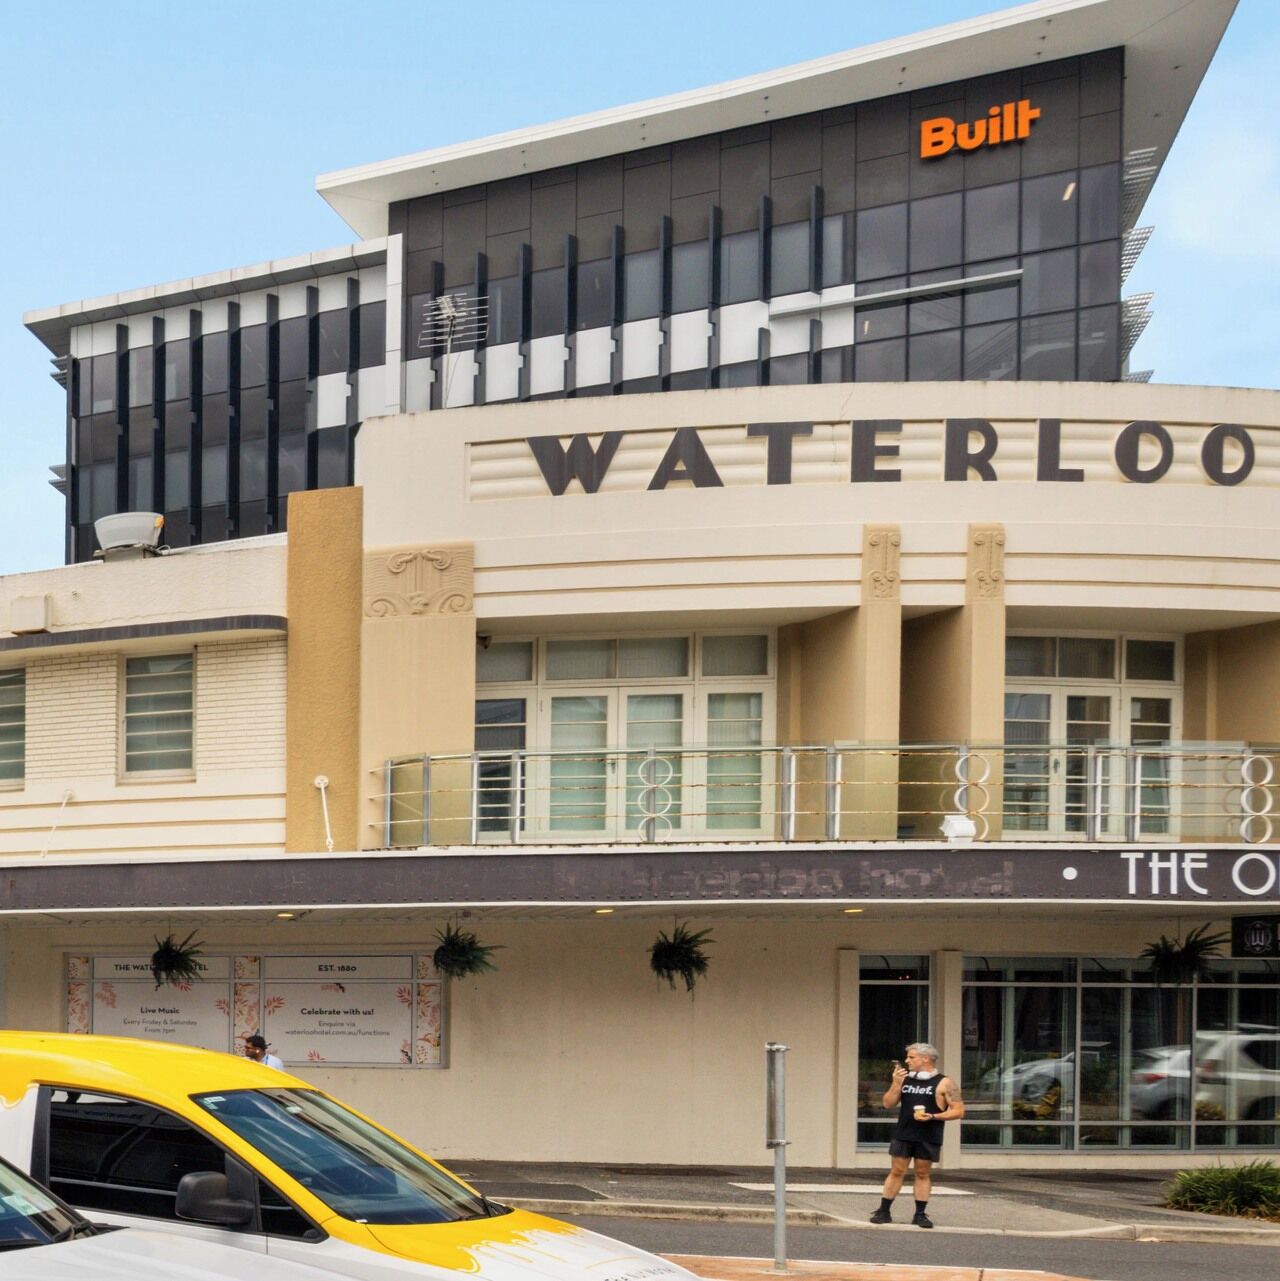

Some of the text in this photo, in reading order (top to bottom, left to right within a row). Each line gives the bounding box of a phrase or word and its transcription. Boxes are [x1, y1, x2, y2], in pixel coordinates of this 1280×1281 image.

[920, 98, 1041, 159] Built
[526, 418, 1256, 496] WATERLOO
[1120, 852, 1280, 896] THE O
[318, 964, 335, 972] EST.
[300, 1008, 341, 1016] Celebrate
[362, 1008, 374, 1016] us!
[169, 1018, 198, 1026] Saturday
[285, 1028, 390, 1037] waterloohotel.com.au/functions
[901, 1084, 933, 1095] Chief.
